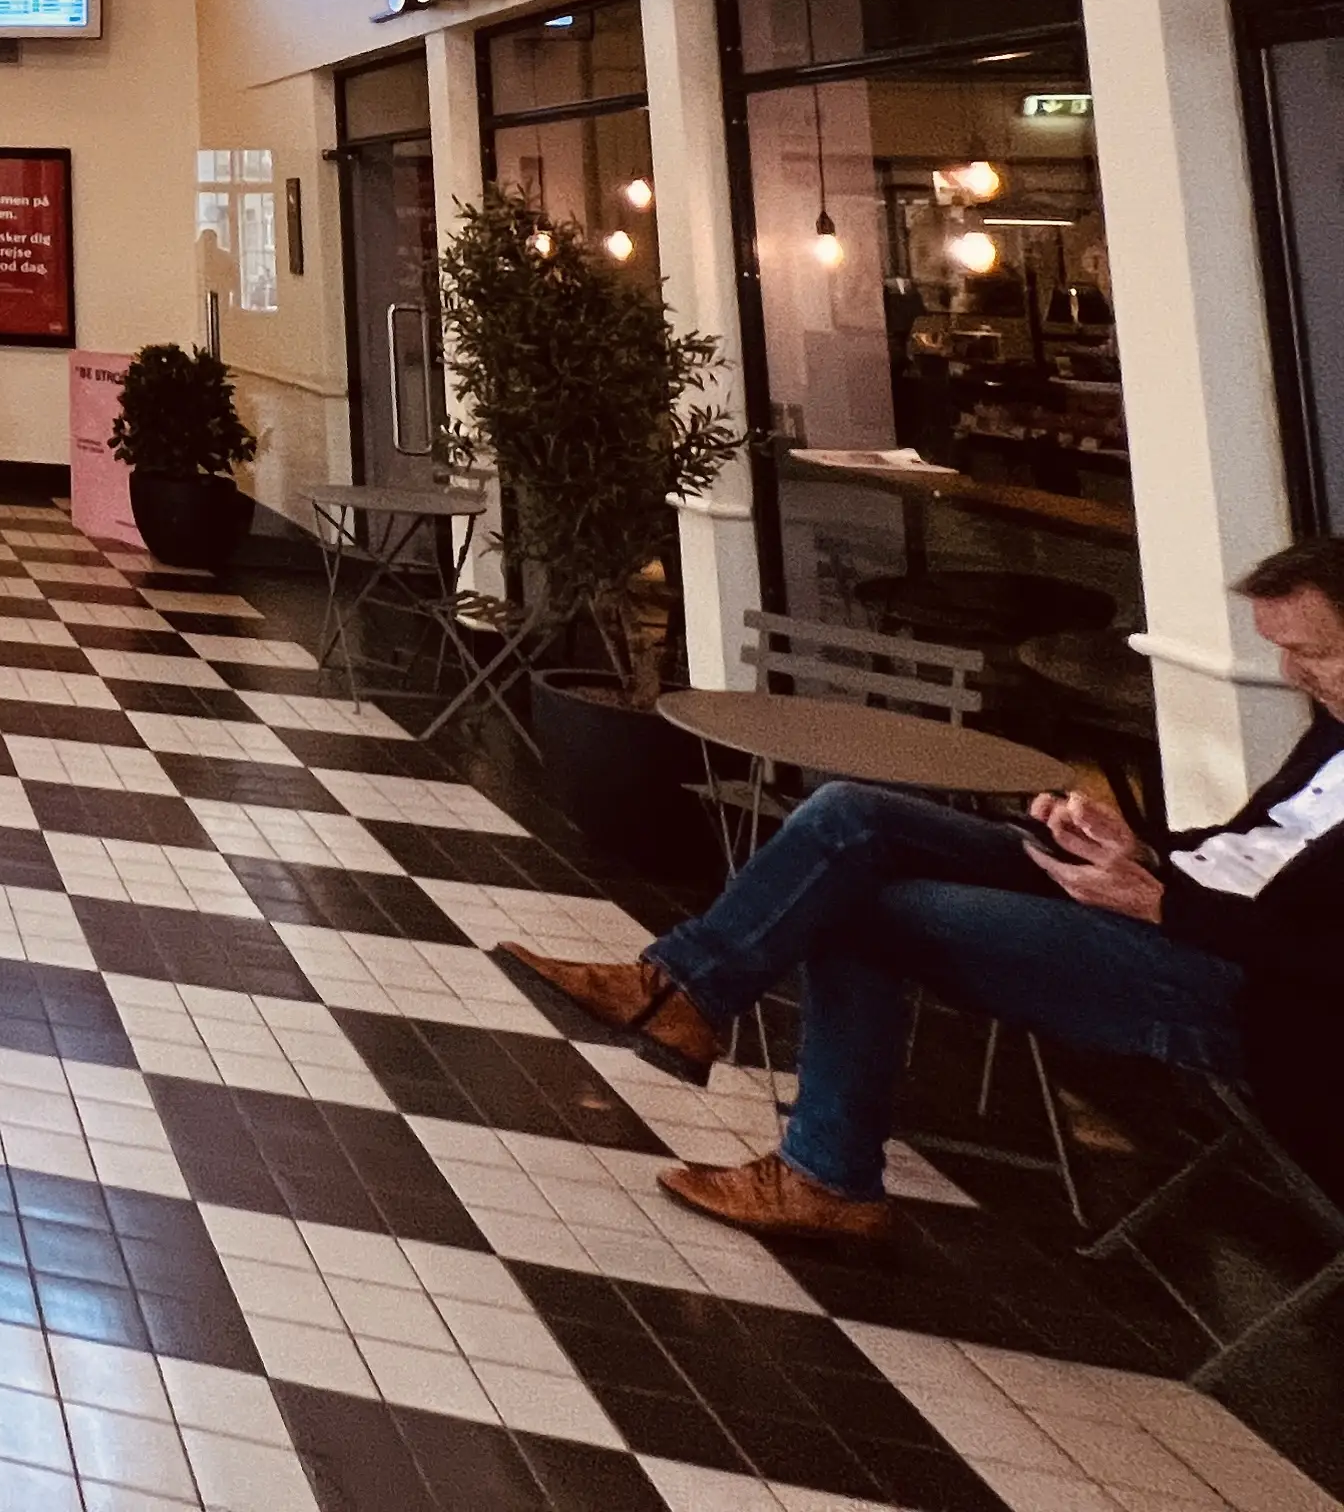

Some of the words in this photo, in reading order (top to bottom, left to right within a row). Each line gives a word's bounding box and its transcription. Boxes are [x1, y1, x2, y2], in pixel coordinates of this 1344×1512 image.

[33, 196, 50, 208] på
[30, 232, 51, 246] dig
[0, 247, 32, 259] rejse
